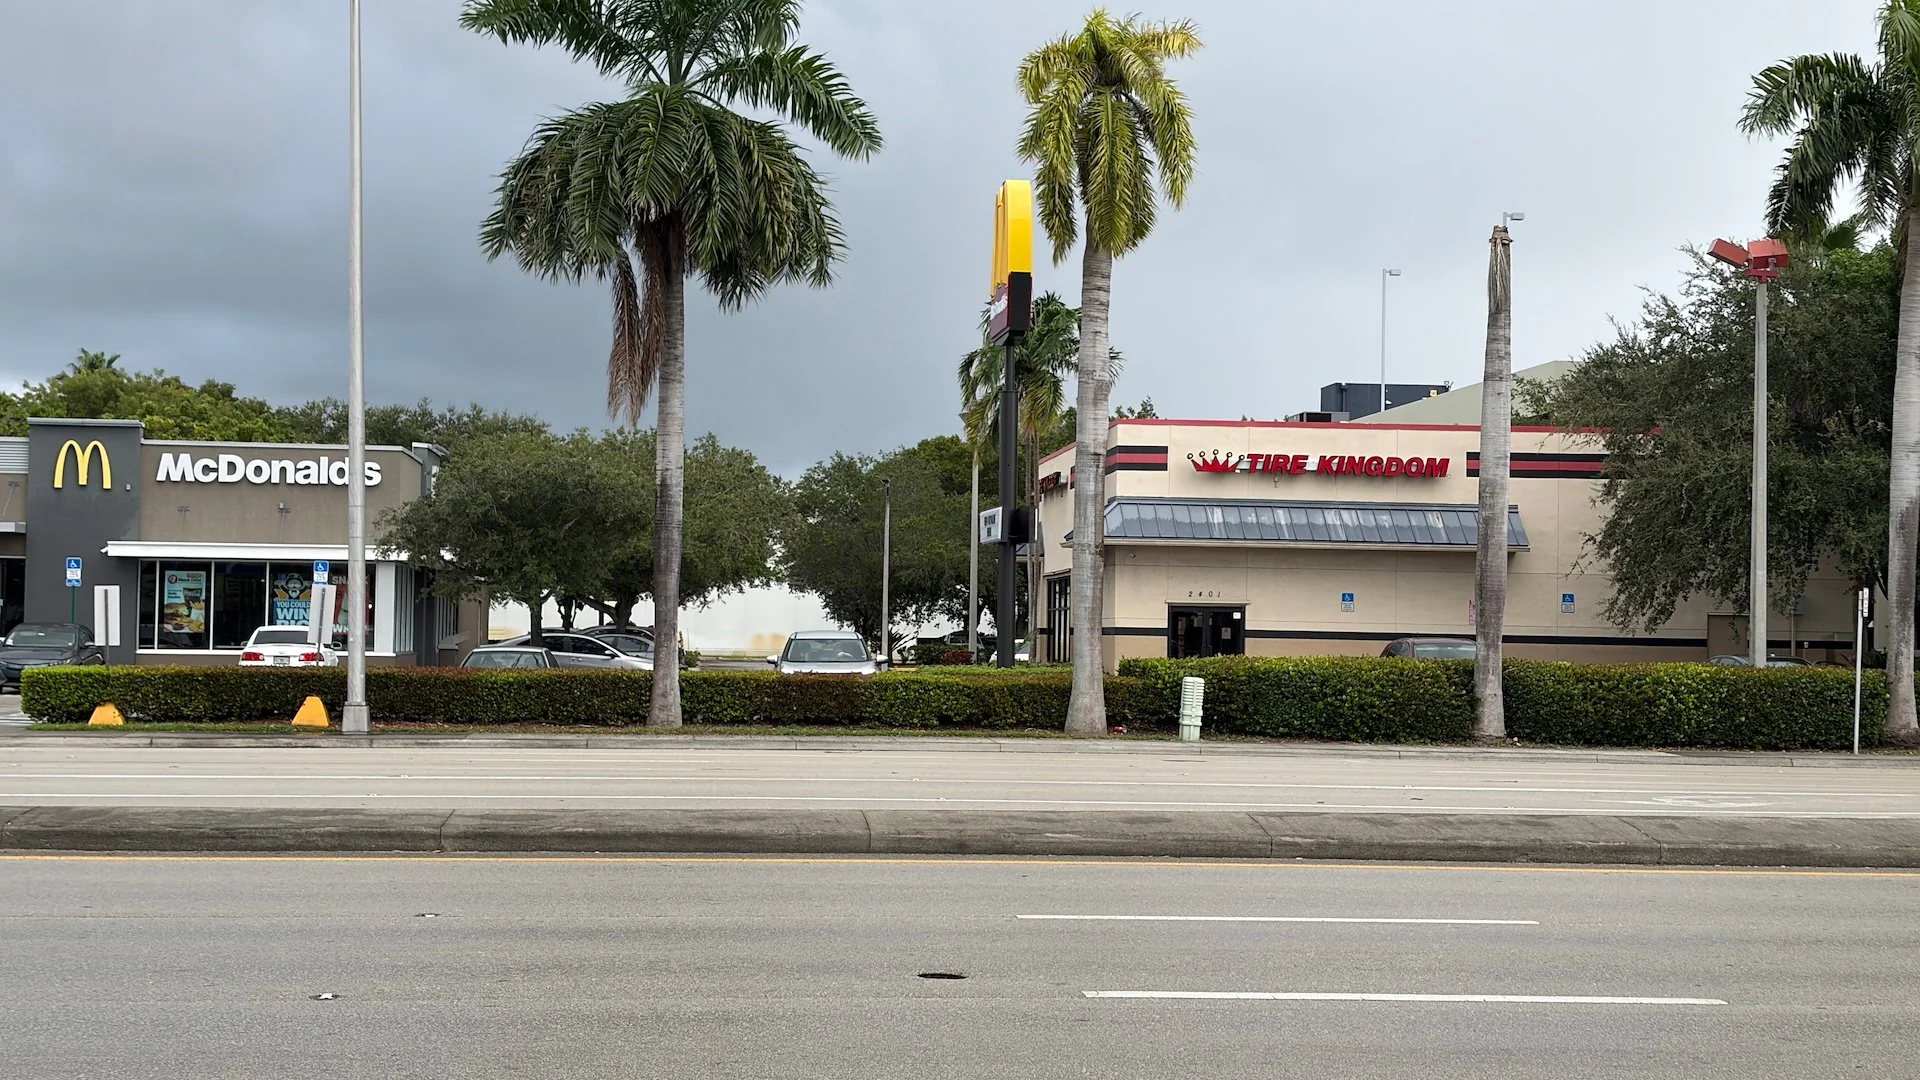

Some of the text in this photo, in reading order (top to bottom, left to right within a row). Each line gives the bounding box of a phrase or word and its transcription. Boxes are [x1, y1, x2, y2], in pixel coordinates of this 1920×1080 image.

[156, 453, 383, 487] McDonalds
[1246, 453, 1450, 478] TIRE KINGDOM
[1188, 590, 1222, 598] 2401
[276, 608, 310, 620] WIN
